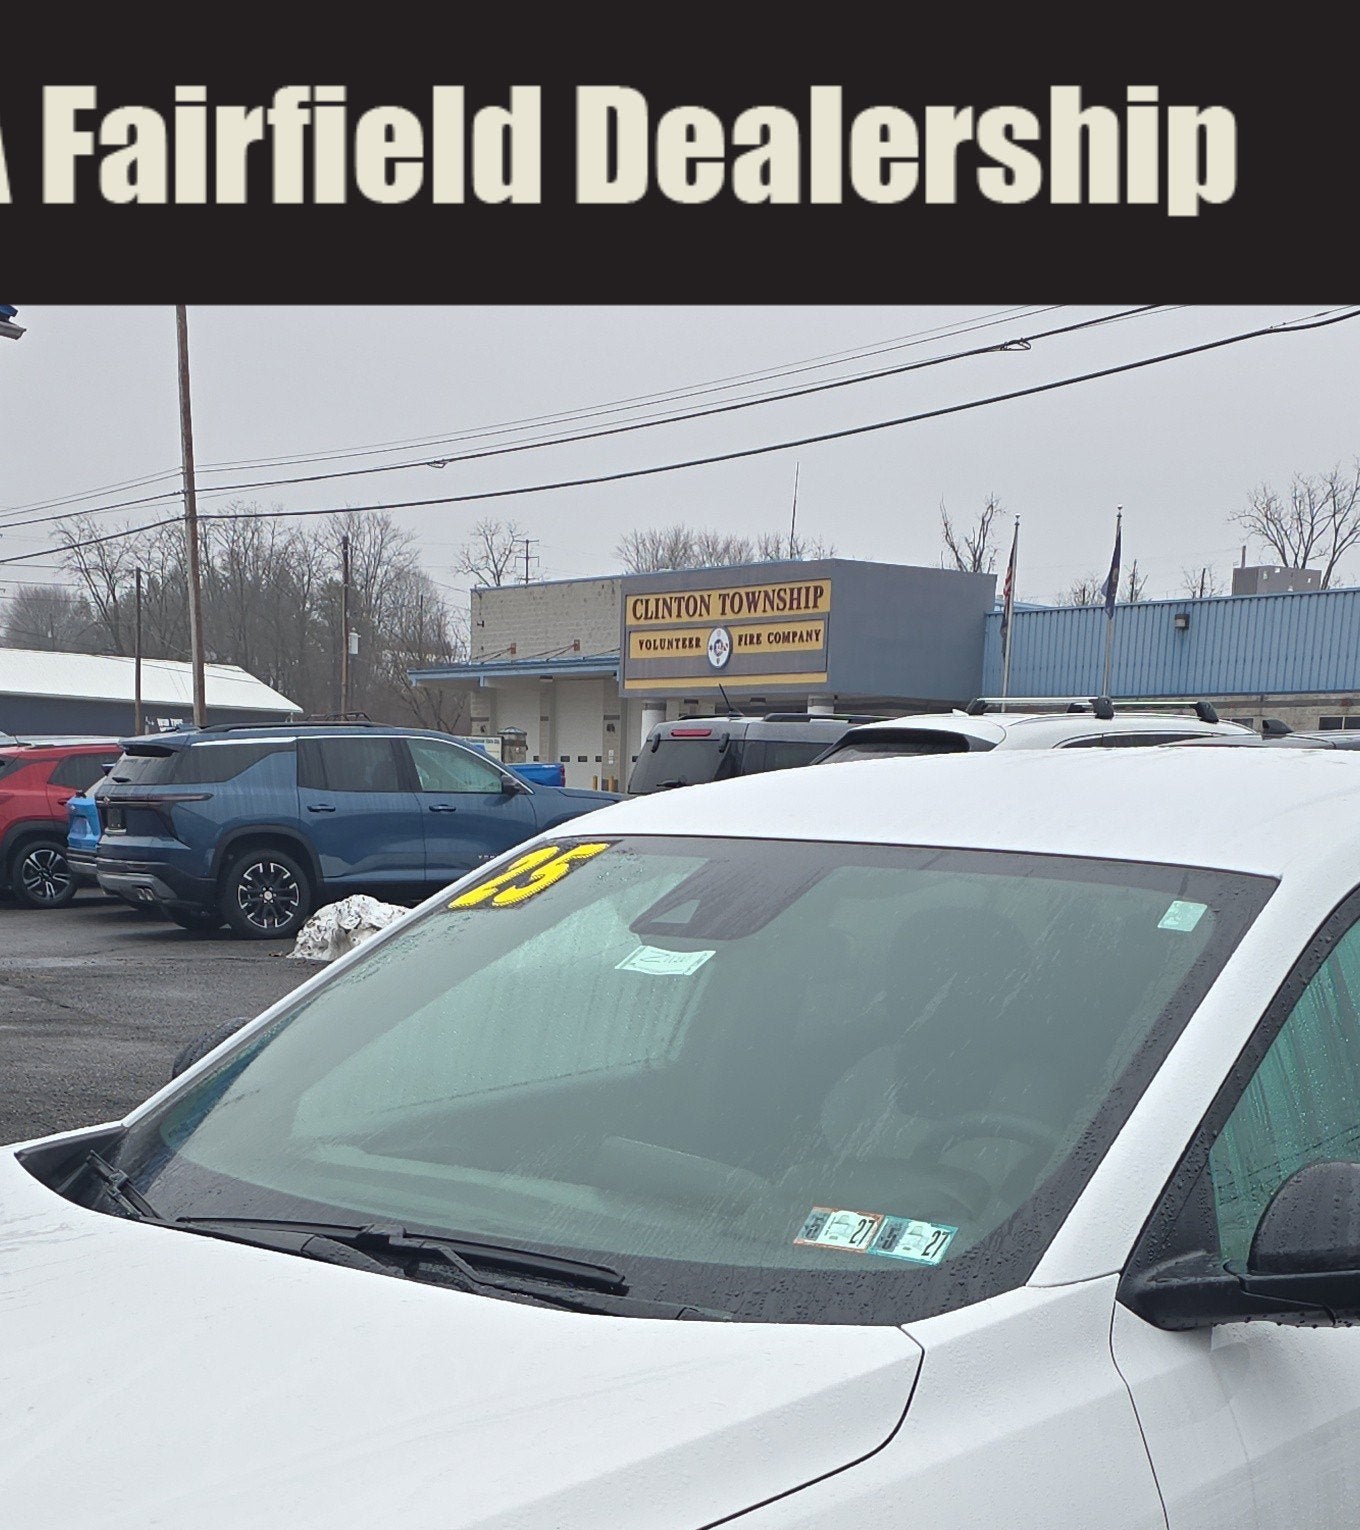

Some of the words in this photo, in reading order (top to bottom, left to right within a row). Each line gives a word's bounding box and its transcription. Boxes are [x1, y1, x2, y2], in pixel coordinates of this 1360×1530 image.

[631, 593, 712, 620] CLINTON
[718, 584, 824, 615] TOWNSHIP
[638, 636, 702, 651] VOLUNTEER
[737, 632, 762, 646] FIRE
[767, 628, 821, 645] COMPANY
[447, 842, 611, 909] 25
[848, 1218, 876, 1248] 27
[921, 1229, 951, 1260] 27
